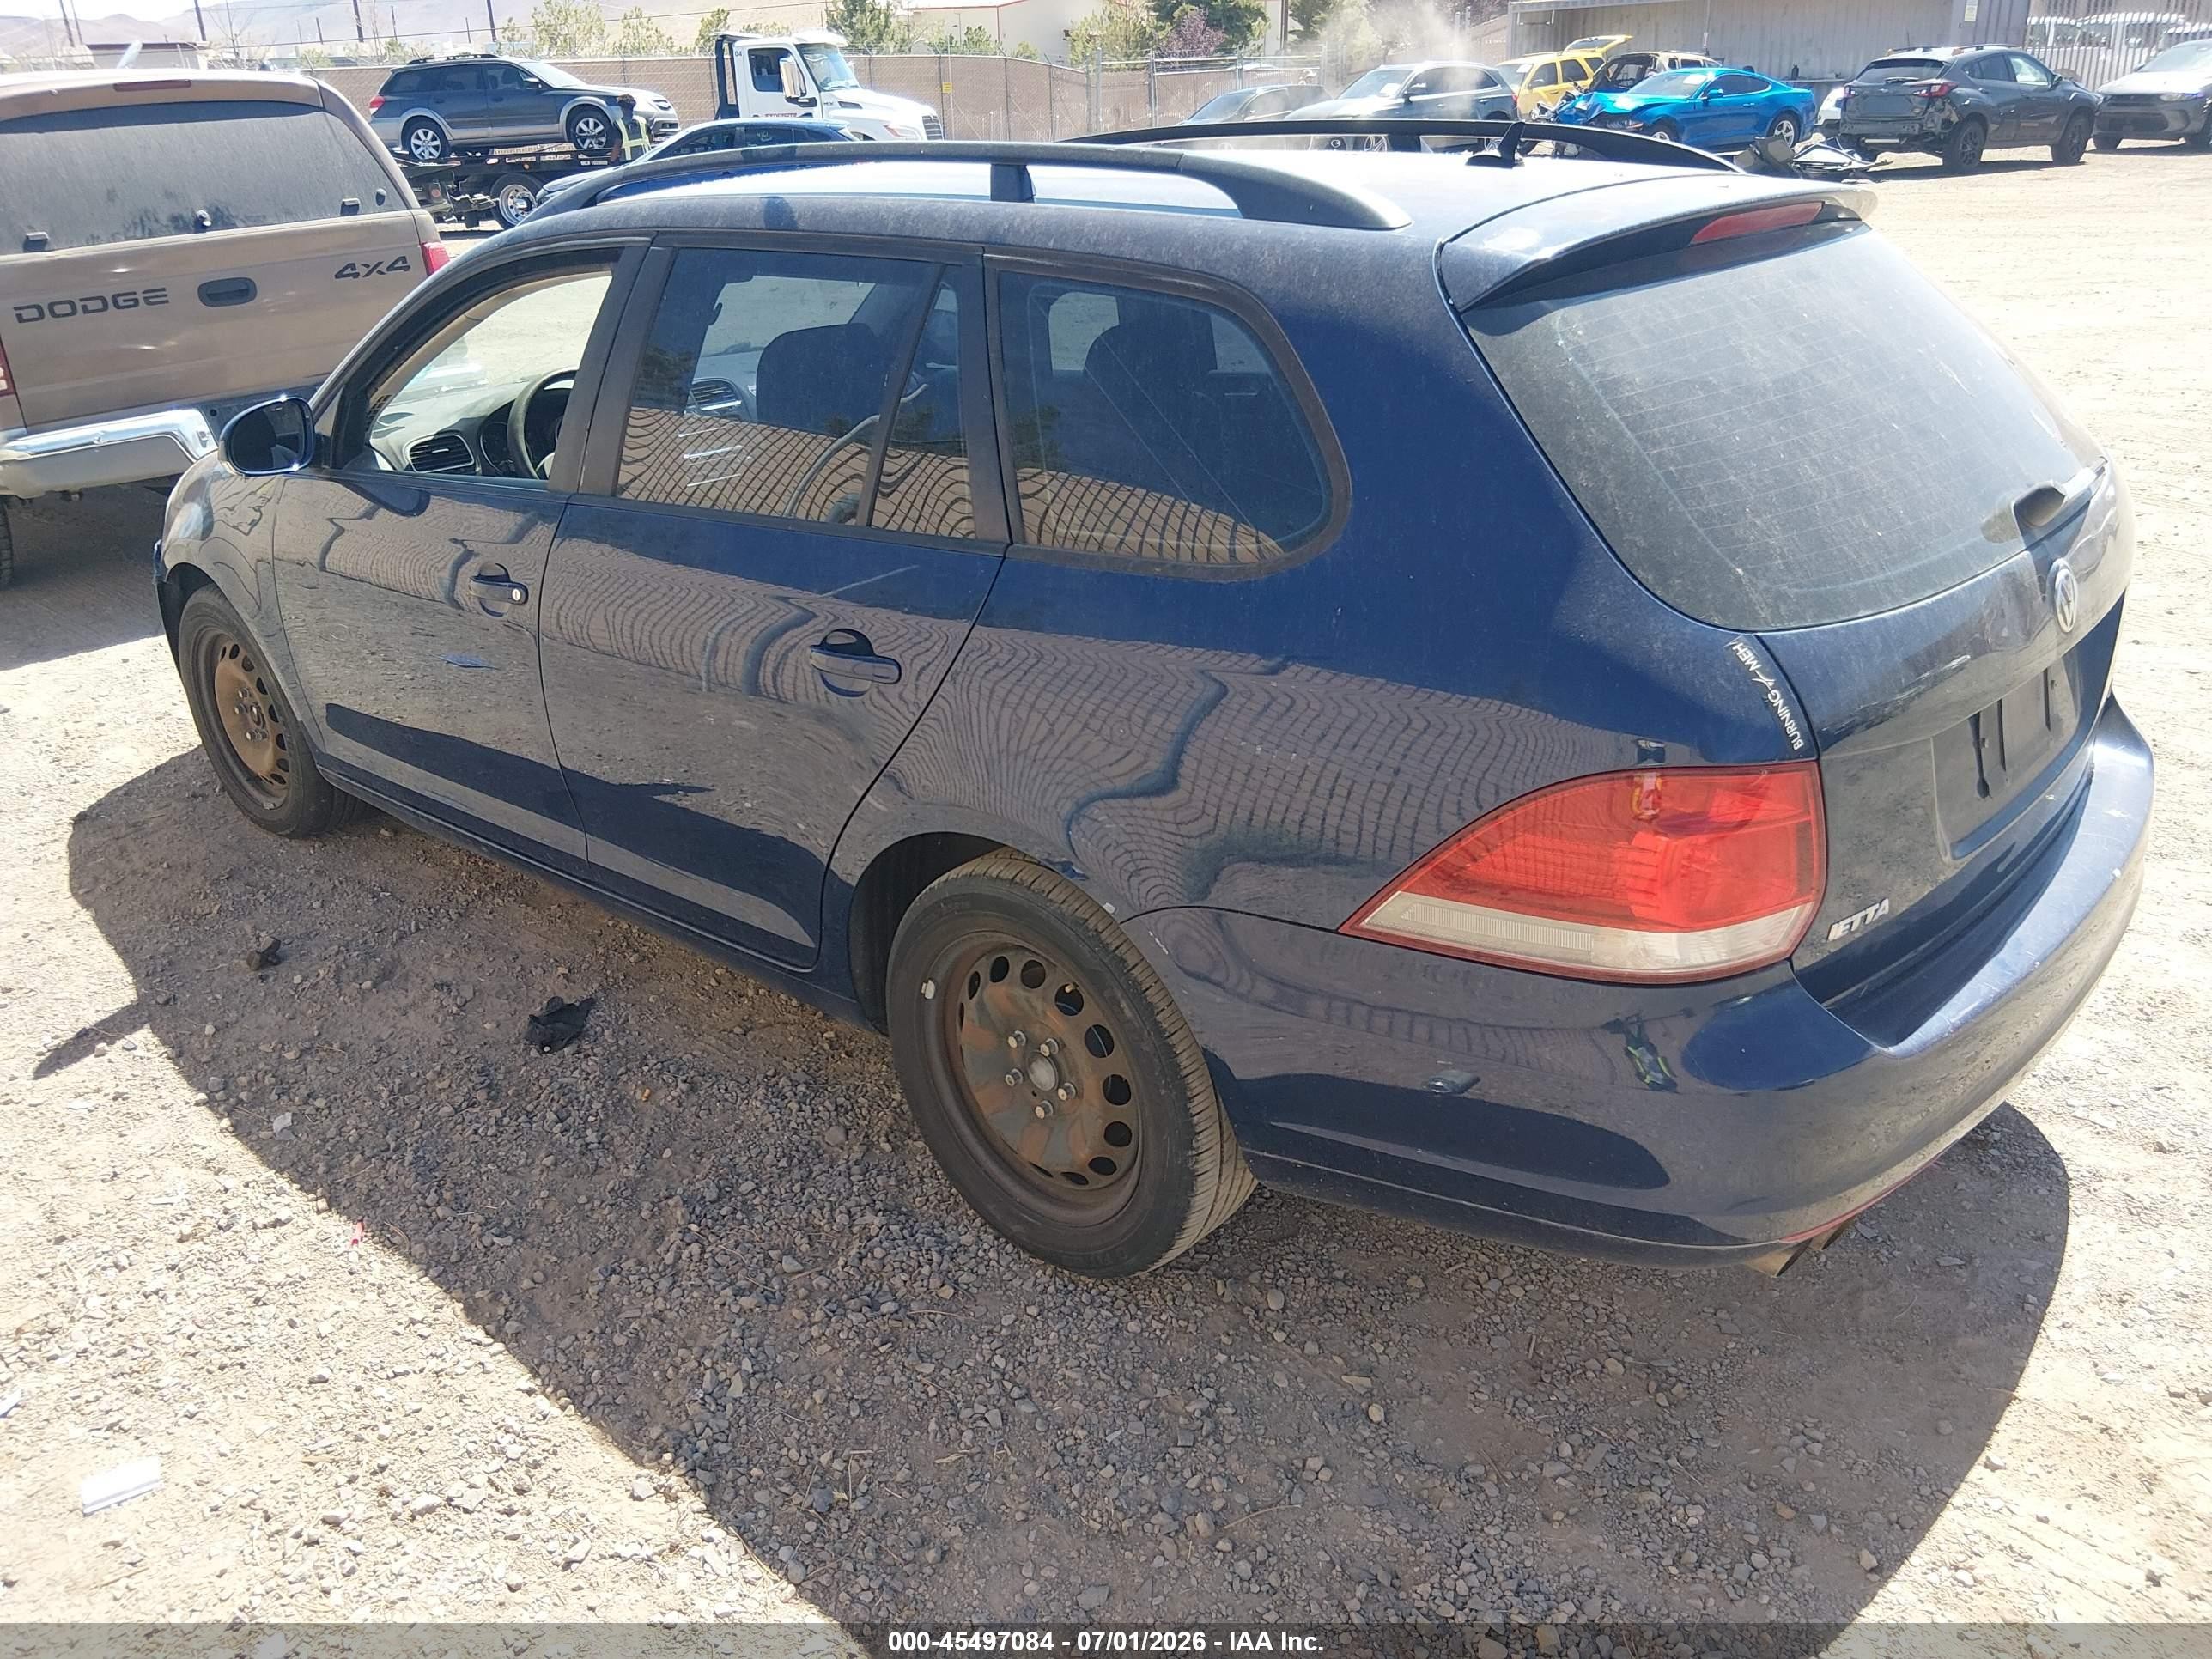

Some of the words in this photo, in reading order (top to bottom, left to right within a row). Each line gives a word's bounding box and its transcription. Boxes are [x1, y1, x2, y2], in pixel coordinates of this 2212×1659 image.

[13, 288, 169, 324] DODGE
[1731, 641, 1762, 672] MEH
[1767, 690, 1804, 750] BURNING
[1826, 898, 1889, 942] JETTA
